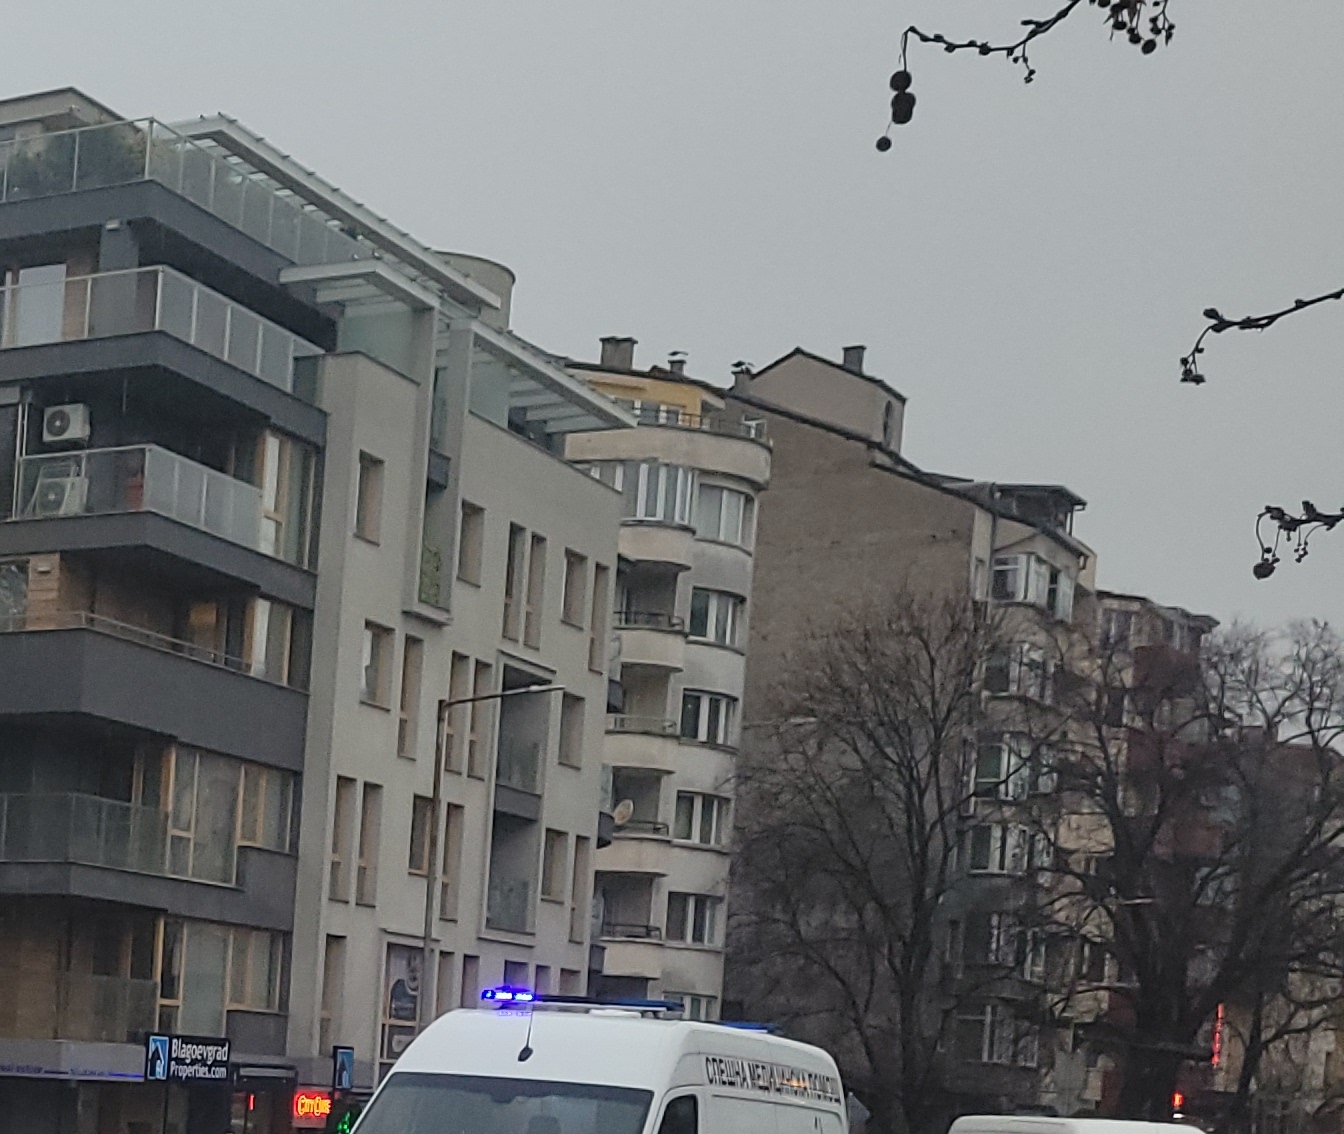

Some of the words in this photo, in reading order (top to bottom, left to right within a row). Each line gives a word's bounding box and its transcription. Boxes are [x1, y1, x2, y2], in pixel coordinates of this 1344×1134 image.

[172, 1038, 229, 1064] Blagoevgrad
[170, 1060, 227, 1080] Properties.com
[705, 1056, 751, 1090] СПЕШНА
